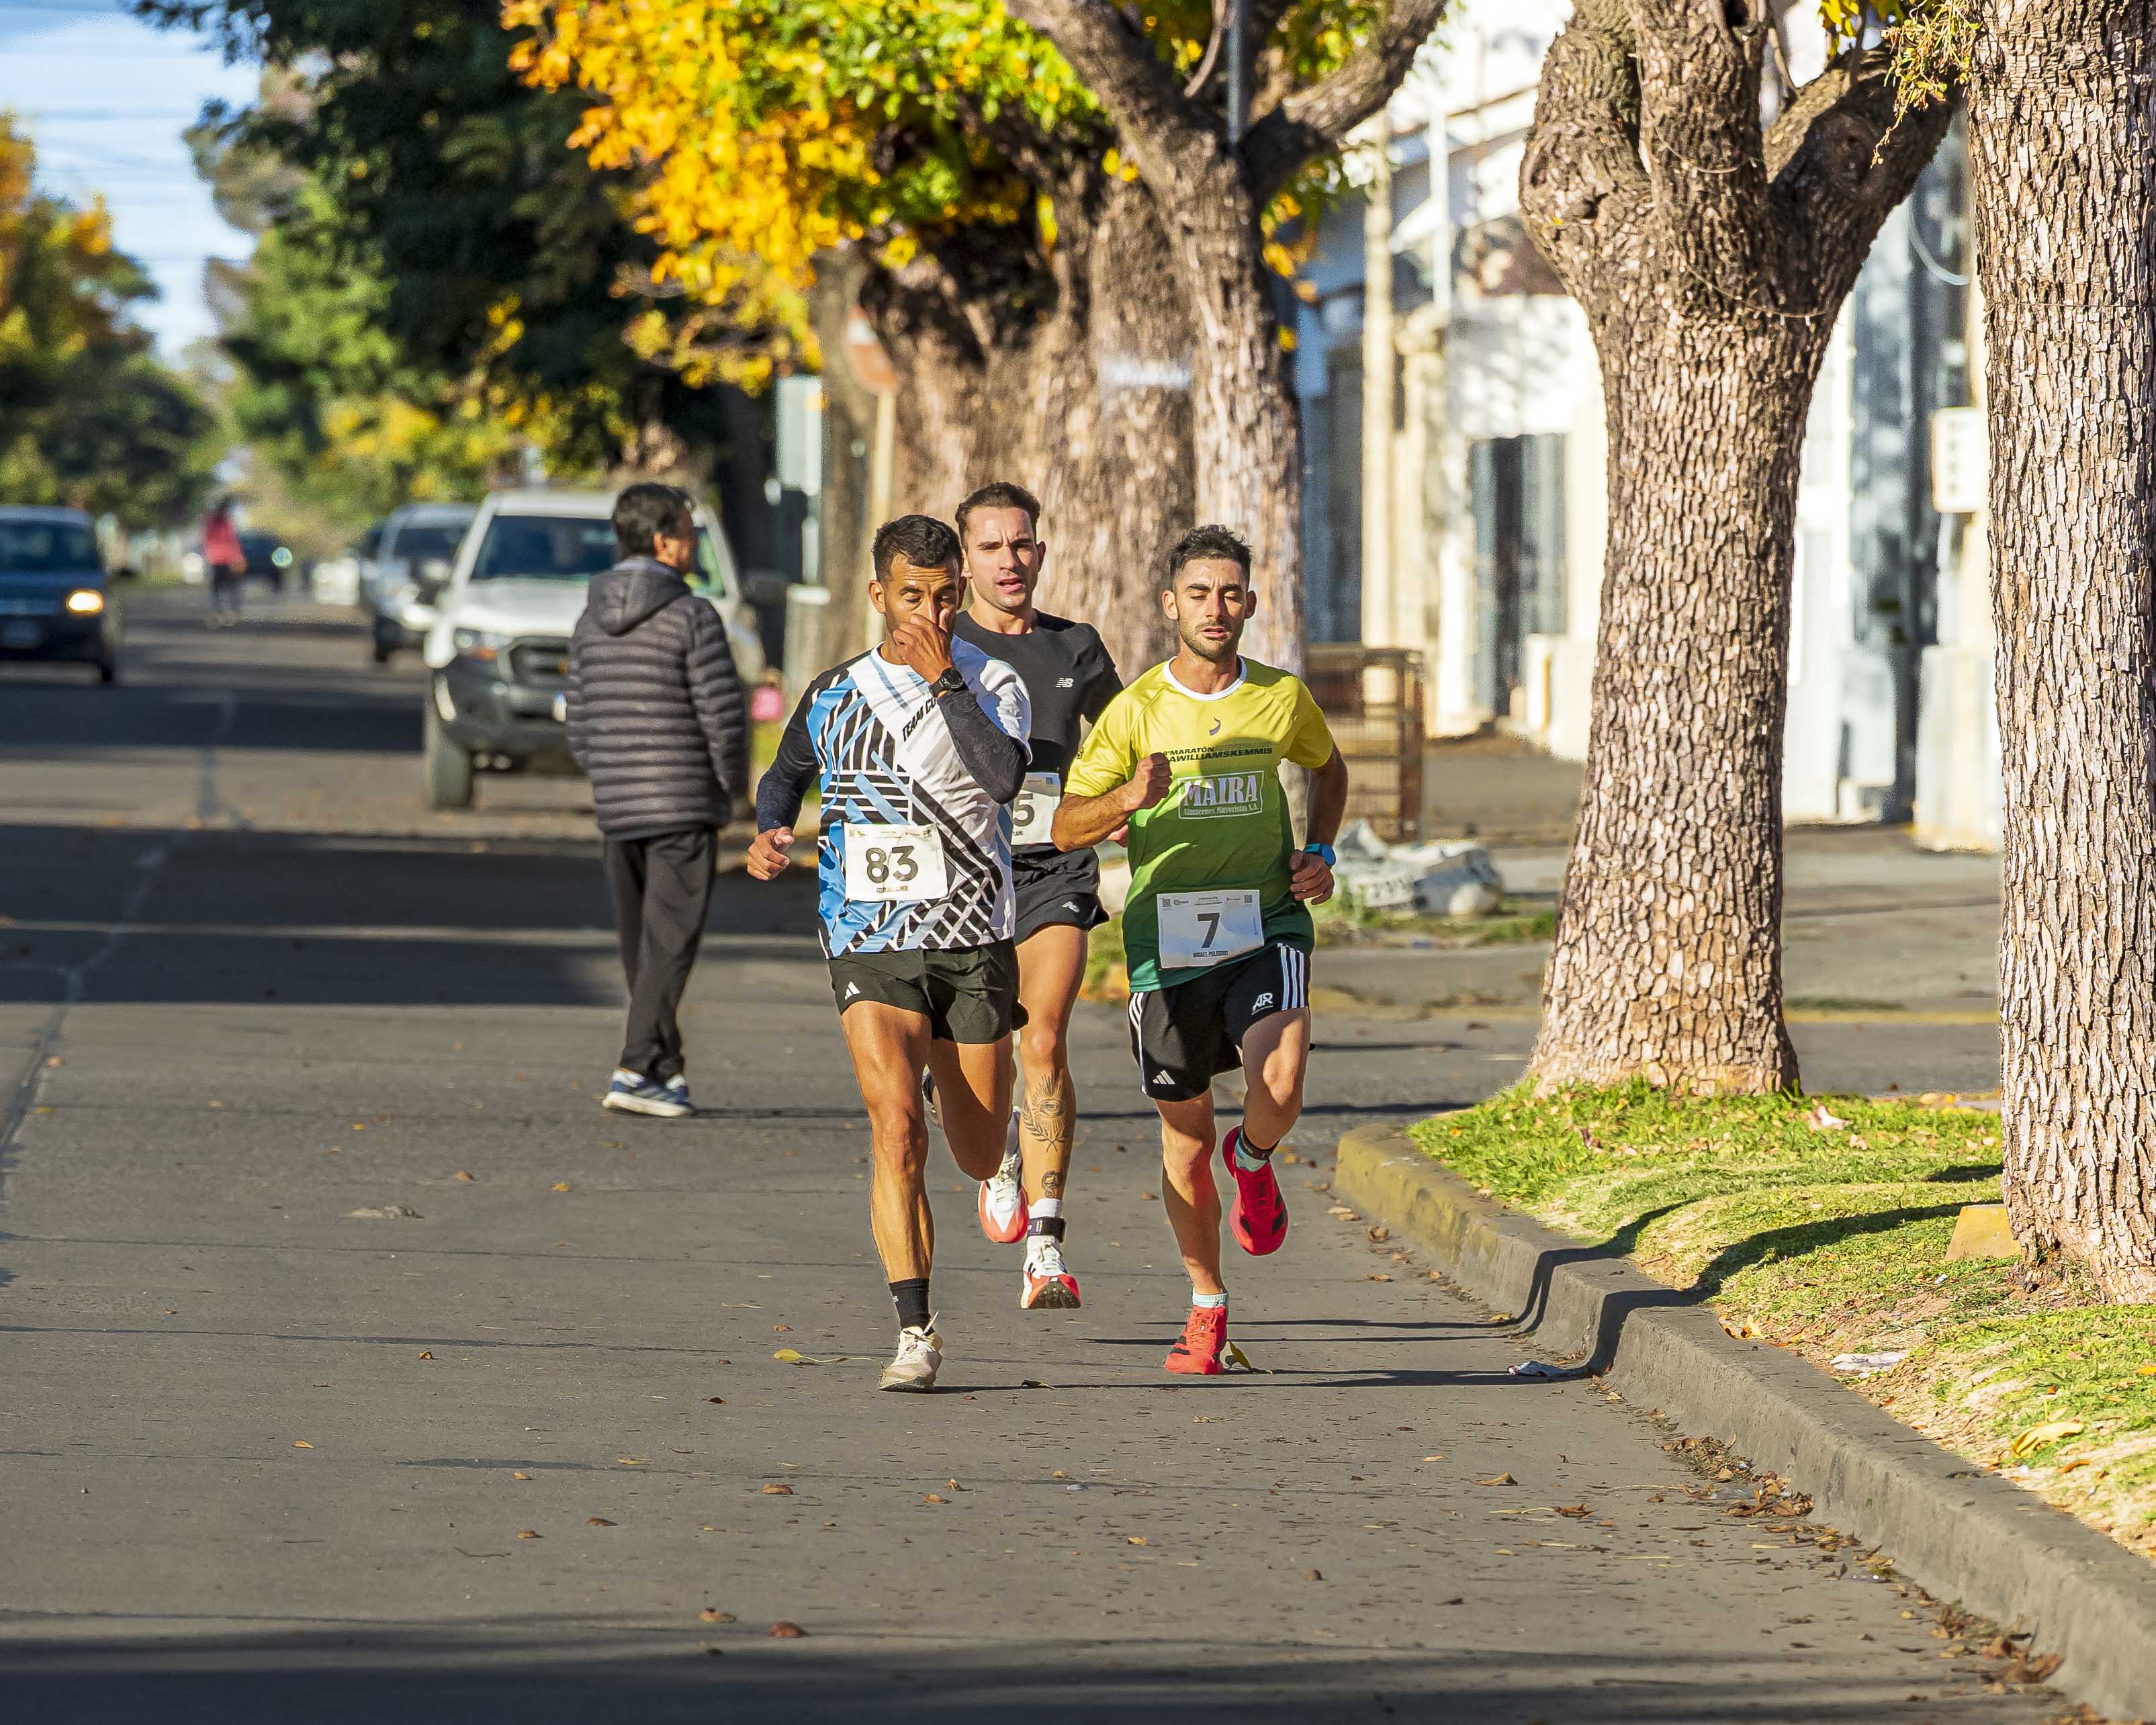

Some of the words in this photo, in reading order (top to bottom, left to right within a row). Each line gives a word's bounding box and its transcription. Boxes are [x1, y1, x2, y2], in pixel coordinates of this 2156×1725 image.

[902, 705, 924, 742] TEAM
[1182, 775, 1258, 807] MAIRA
[865, 845, 918, 883] 83
[1197, 912, 1220, 948] 7
